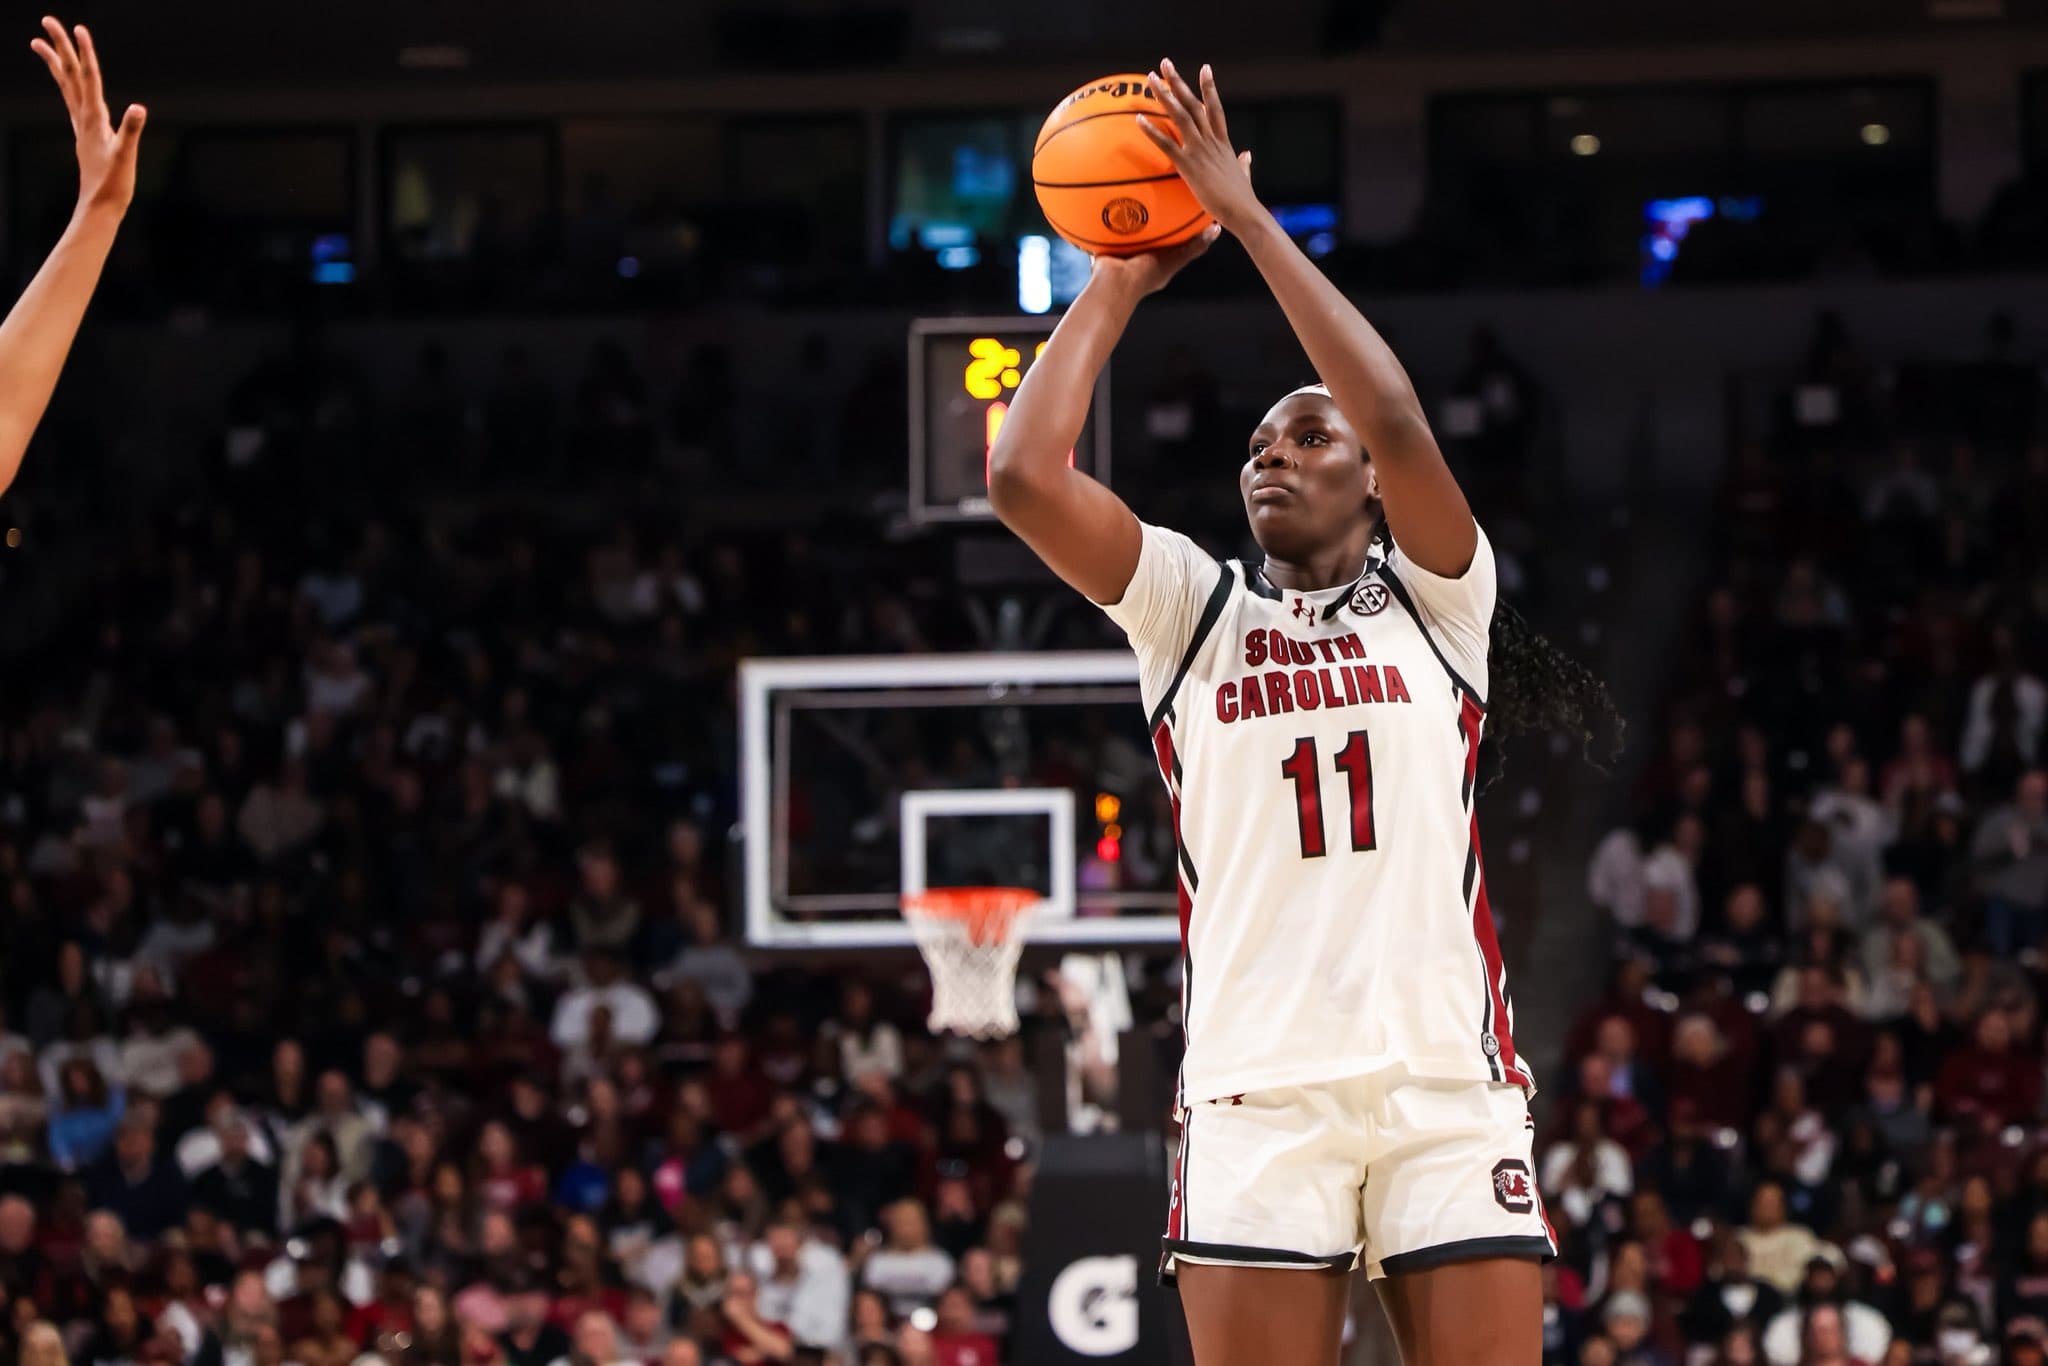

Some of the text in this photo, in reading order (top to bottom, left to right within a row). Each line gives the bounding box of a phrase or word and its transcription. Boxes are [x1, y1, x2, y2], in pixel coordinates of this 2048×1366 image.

[965, 338, 1048, 399] 2:
[1350, 585, 1389, 615] SEC
[1245, 628, 1367, 667] SOUTH
[1216, 665, 1412, 724] CAROLINA
[1281, 729, 1377, 860] 11
[1048, 1254, 1139, 1357] G
